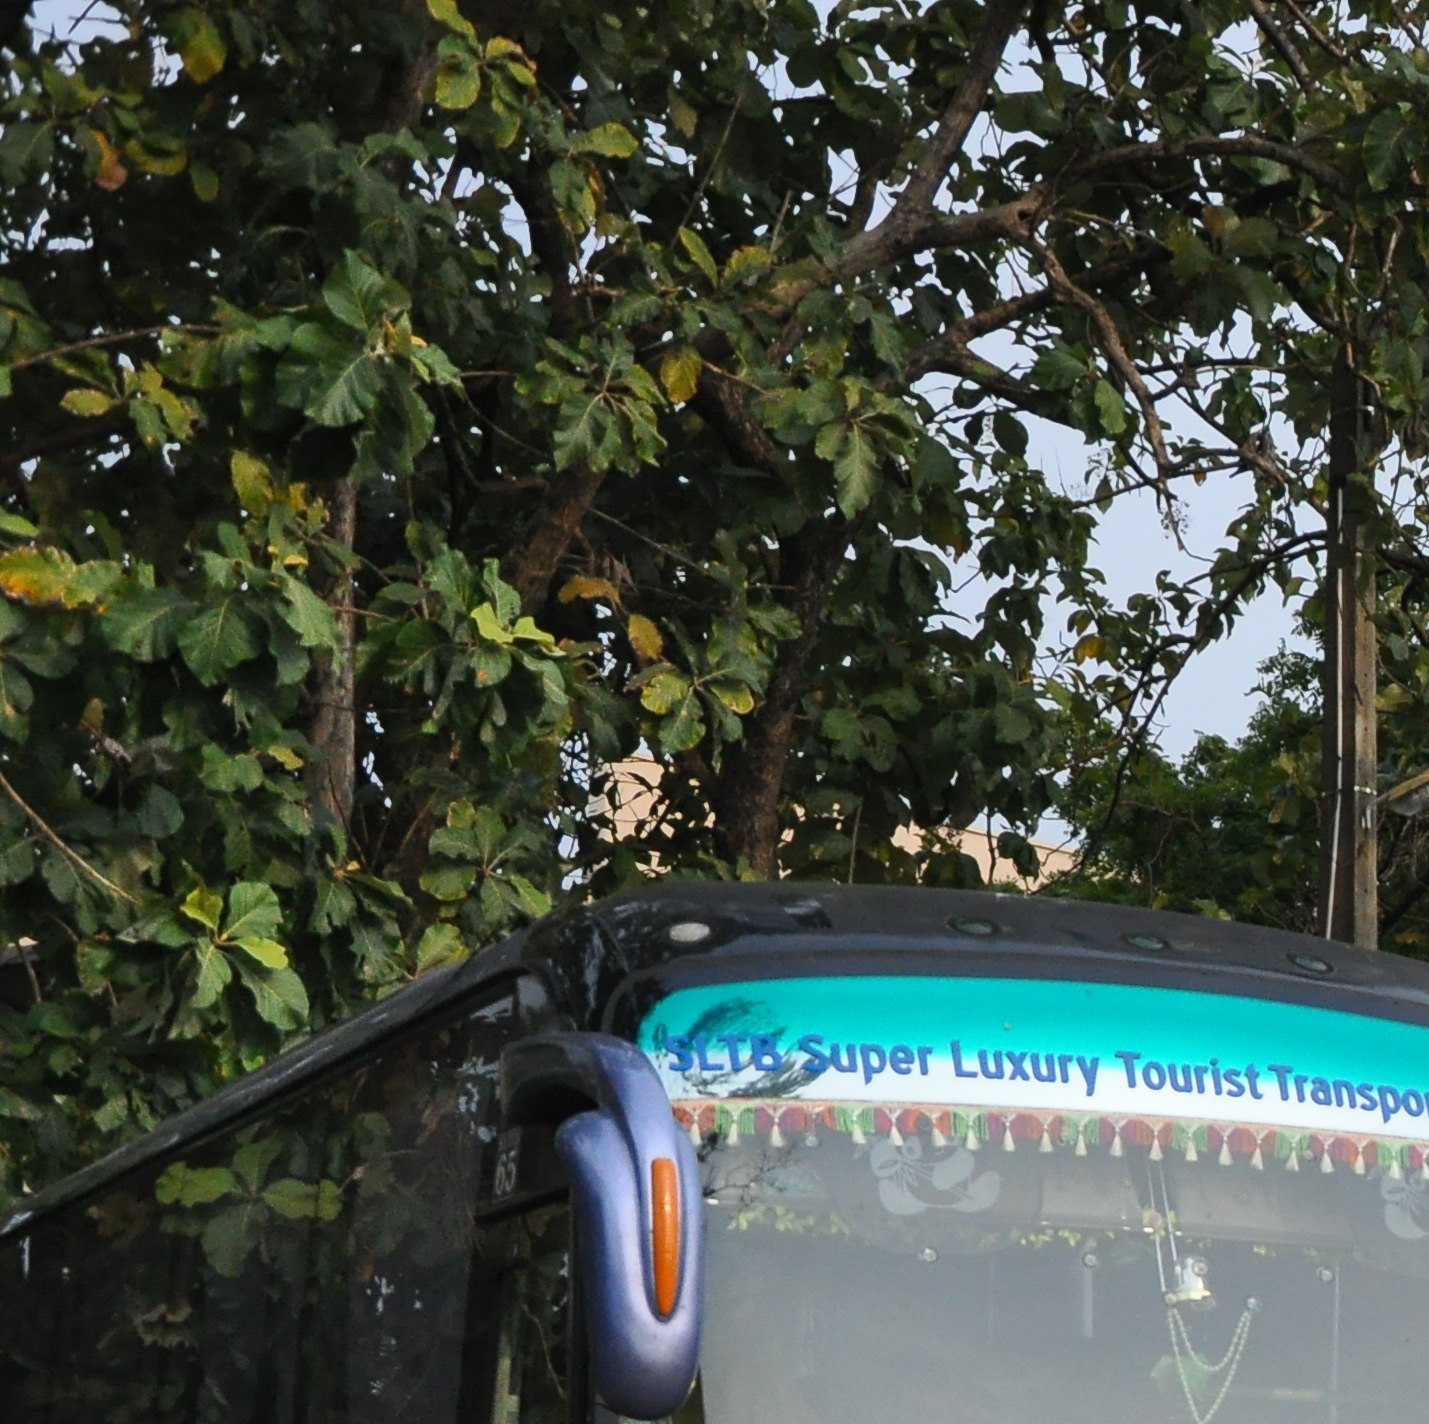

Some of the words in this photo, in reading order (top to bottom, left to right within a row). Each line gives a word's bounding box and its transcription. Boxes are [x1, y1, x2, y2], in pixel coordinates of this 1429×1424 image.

[664, 1033, 782, 1073] SLTB
[799, 1033, 933, 1085] Super
[950, 1040, 1099, 1097] Luxury
[1115, 1051, 1263, 1101] Tourist
